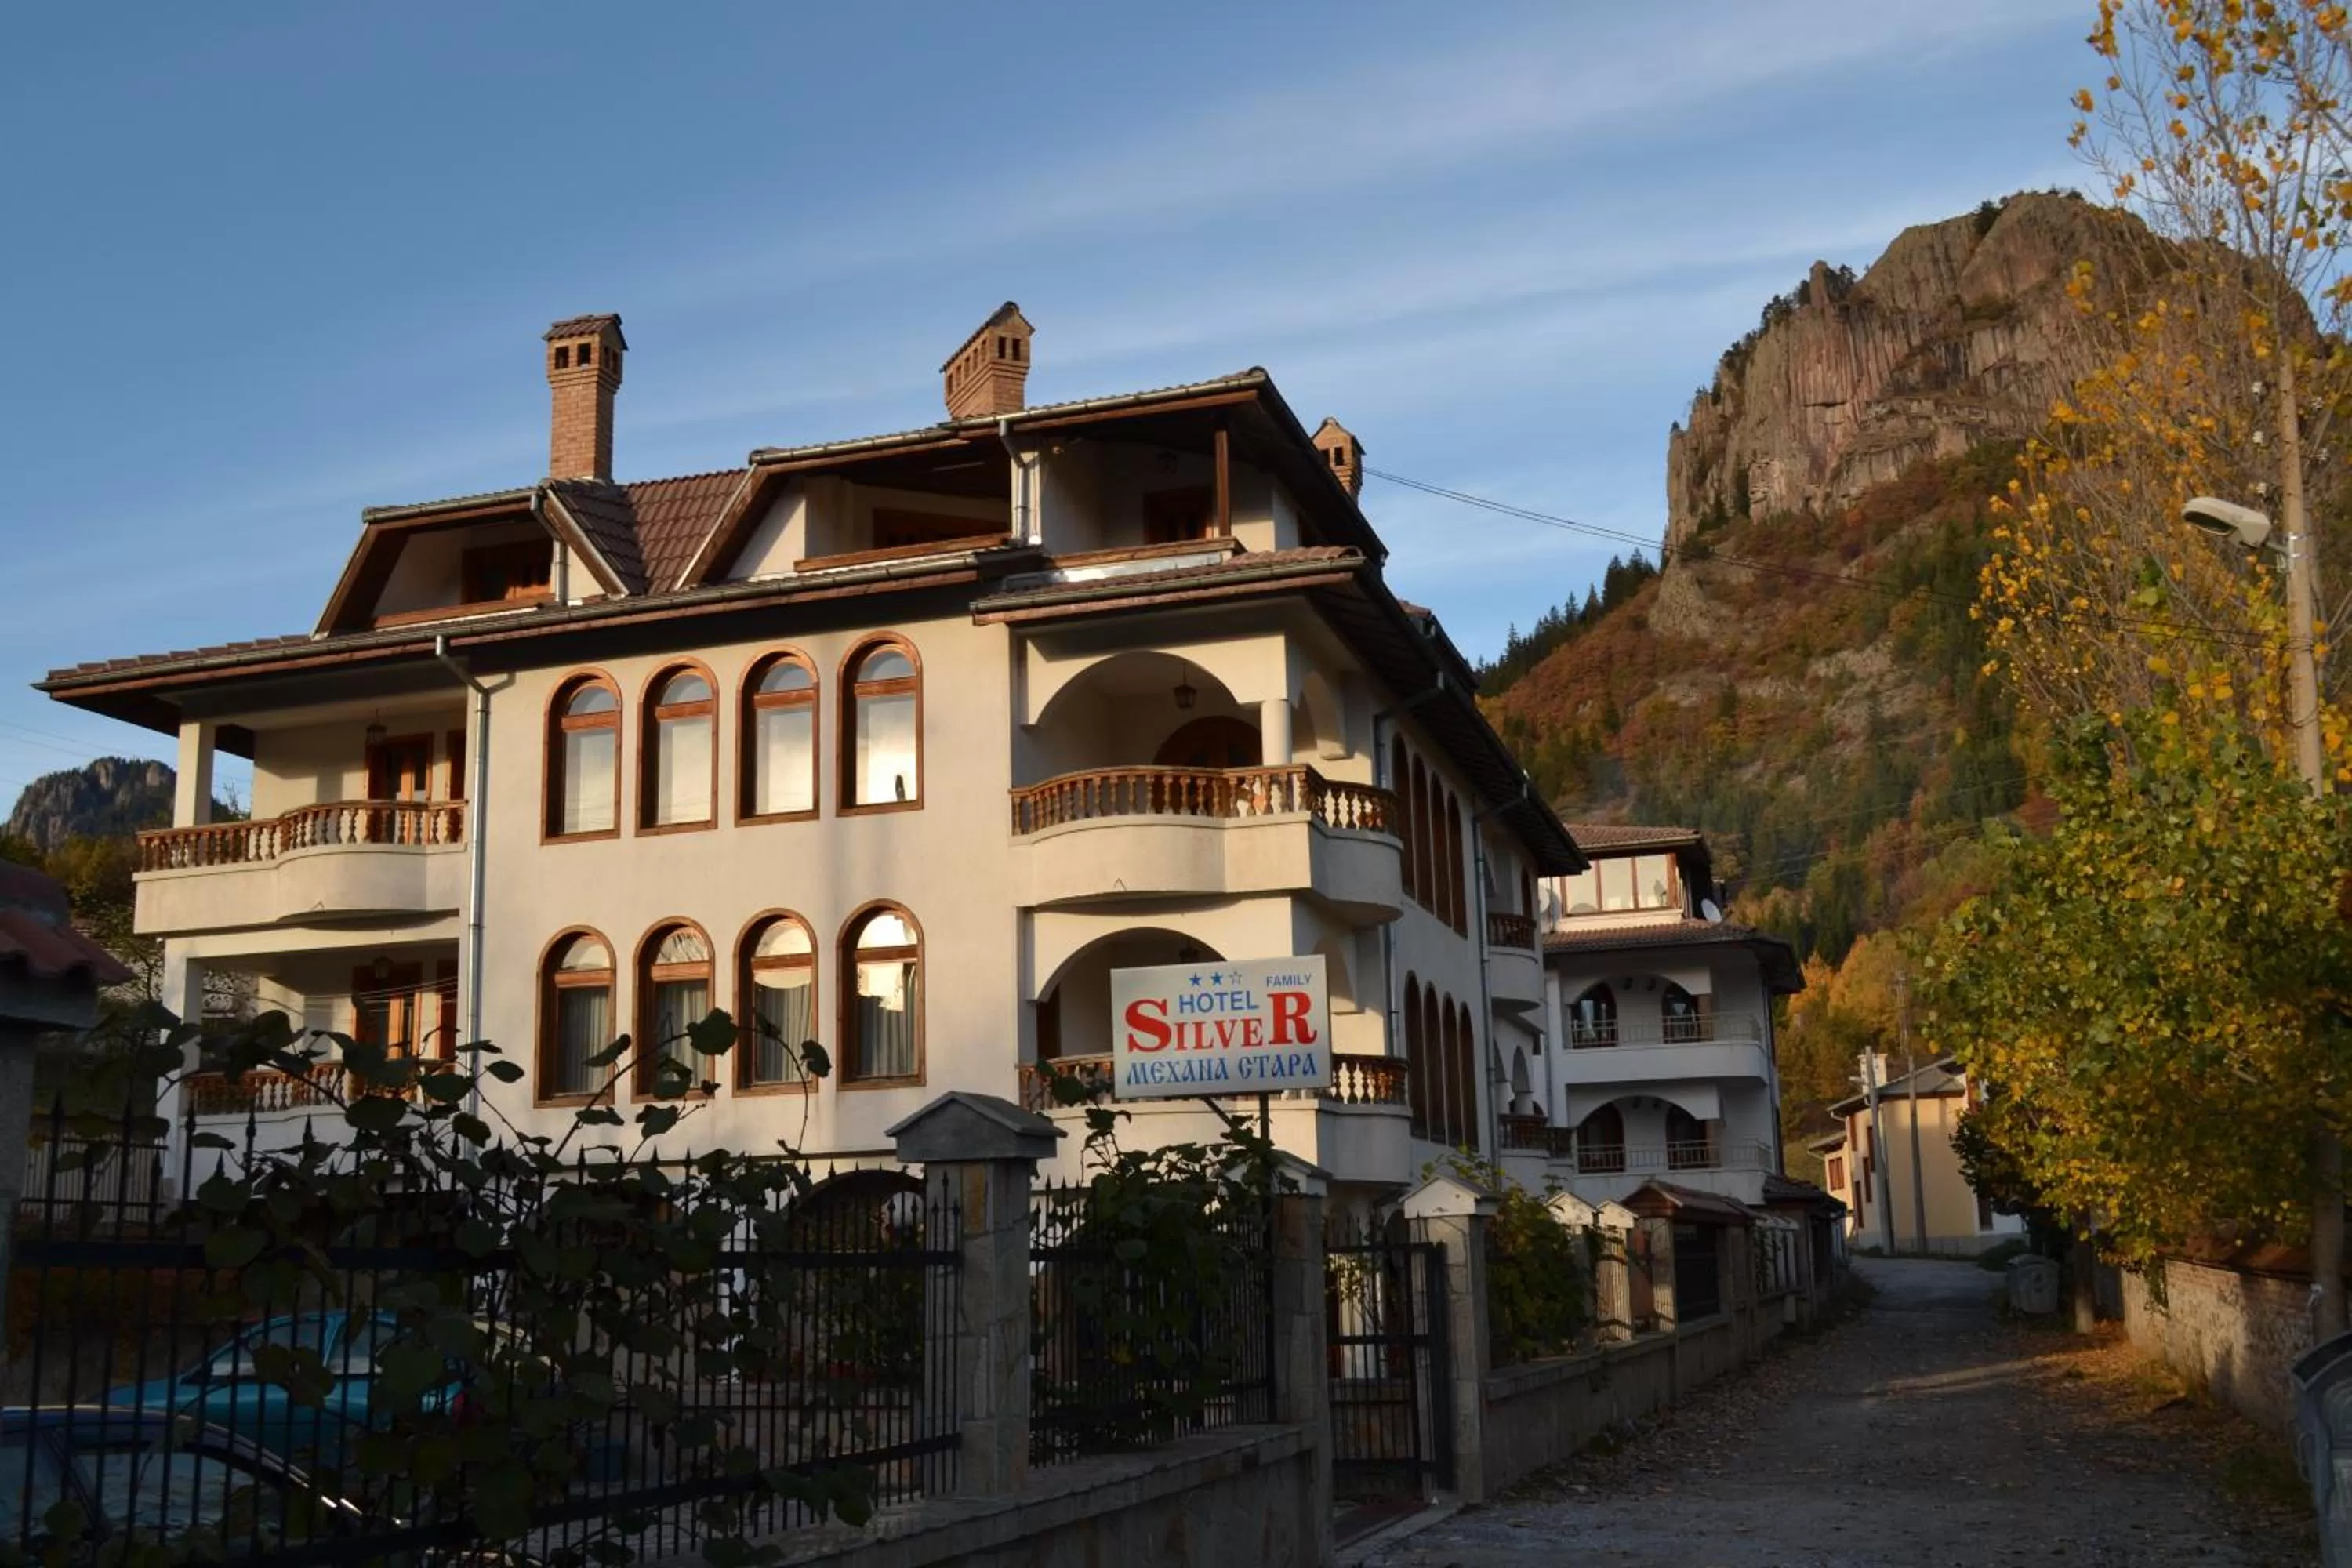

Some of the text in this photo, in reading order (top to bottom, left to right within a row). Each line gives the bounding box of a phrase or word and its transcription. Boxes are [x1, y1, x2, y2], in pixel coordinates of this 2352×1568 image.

[1266, 973, 1312, 987] FAMILY
[1178, 991, 1259, 1014] HOTEL
[1125, 992, 1318, 1053] SILVER
[1127, 1053, 1317, 1085] МЕХАНА СТАРА
